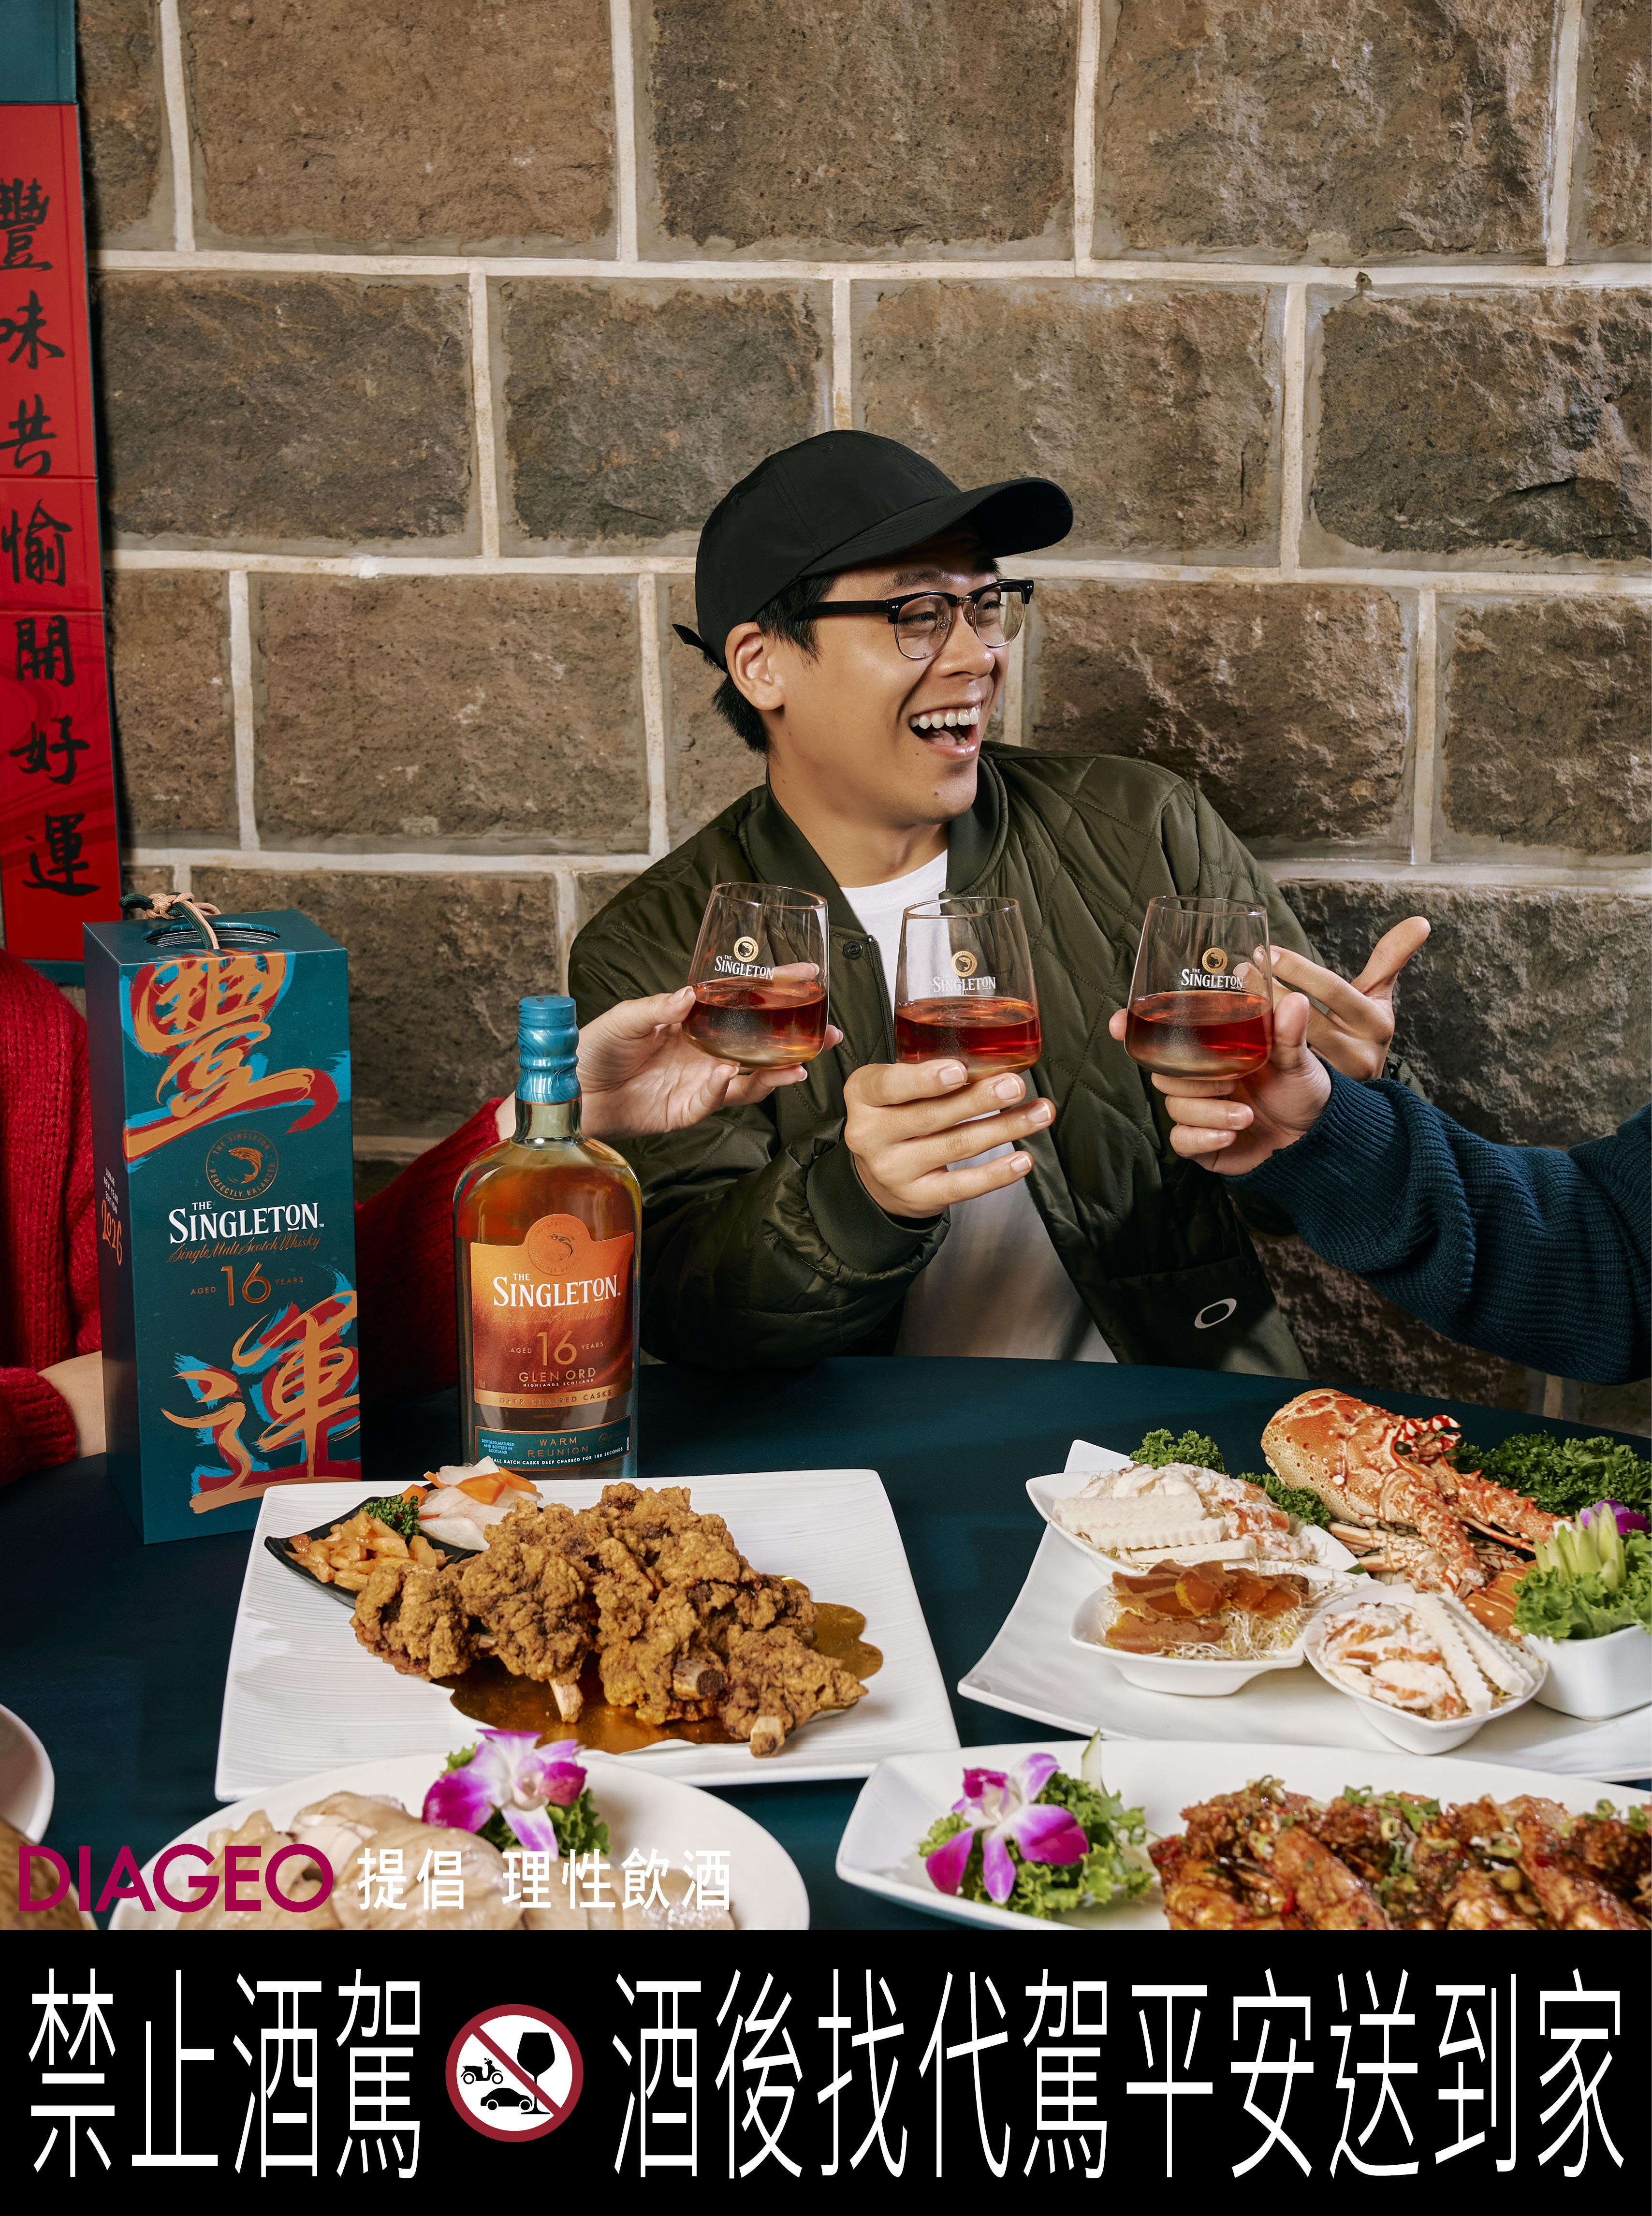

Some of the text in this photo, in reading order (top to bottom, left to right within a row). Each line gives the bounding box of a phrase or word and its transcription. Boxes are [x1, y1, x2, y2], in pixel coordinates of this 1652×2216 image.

[715, 955, 774, 980] SINGLETON
[932, 976, 996, 992] SINGLETON
[1181, 969, 1243, 989] SINGLETON
[213, 1133, 270, 1155] THE SINGLETON
[209, 1163, 275, 1197] PERFECTLY BALANCED
[192, 1201, 212, 1210] THE
[102, 1199, 122, 1266] 2026
[169, 1203, 319, 1244] SINGLETON
[166, 1233, 321, 1264] Single Malt Scotch Whisky
[190, 1262, 304, 1306] AGED 16 YEARS
[493, 1275, 618, 1307] SINGLETON
[537, 1330, 577, 1366] 16
[581, 1341, 604, 1350] YEARS
[519, 1367, 596, 1382] GLEN ORD
[530, 1396, 577, 1405] CHARRED
[583, 1390, 612, 1401] CASKS
[527, 1446, 588, 1458] REUNION
[539, 1437, 577, 1446] WARM
[604, 1447, 623, 1456] SECONDS
